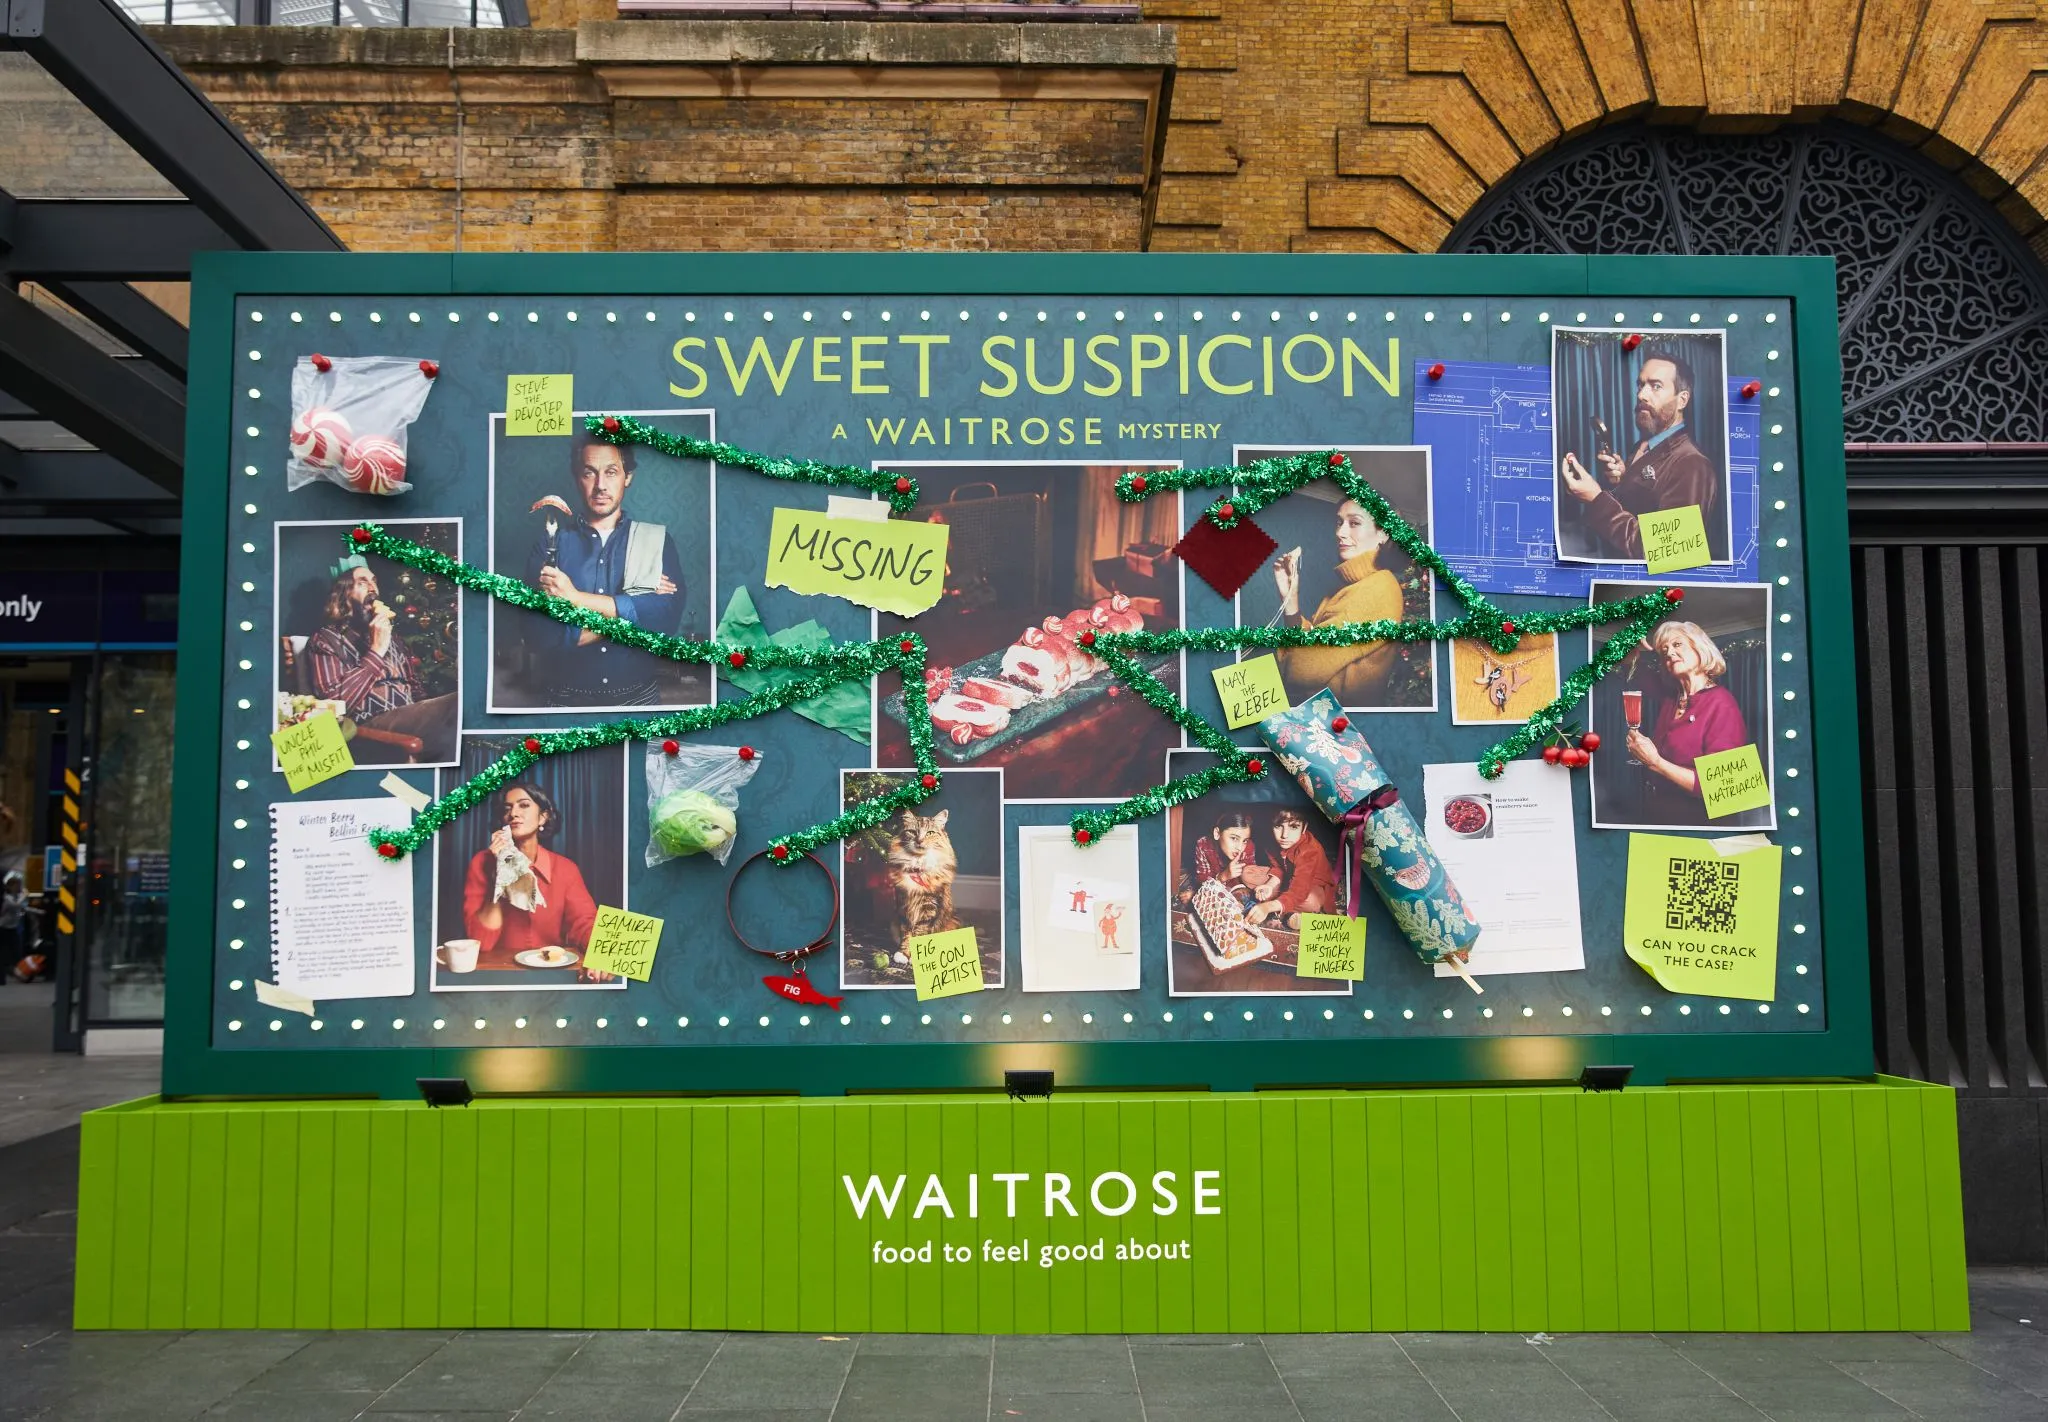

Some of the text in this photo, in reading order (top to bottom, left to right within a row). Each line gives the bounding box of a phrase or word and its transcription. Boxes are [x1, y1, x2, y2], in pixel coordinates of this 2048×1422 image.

[670, 334, 1400, 398] SWEET SUSPICION
[514, 376, 549, 395] STEVE
[524, 394, 542, 405] THE
[515, 400, 563, 421] DEVOTED
[536, 415, 565, 433] COOK
[831, 417, 1222, 445] A WAITROSE MYSTERY
[1651, 518, 1681, 536] DAVID
[1647, 533, 1704, 562] DETECTIVE
[1659, 533, 1673, 544] THE
[779, 523, 934, 586] MISSING
[1222, 669, 1247, 693] MAY
[1241, 683, 1256, 697] THE
[1233, 687, 1281, 721] REBEL
[279, 722, 315, 755] UNCLE
[299, 739, 325, 760] PHIL
[287, 746, 346, 780] THE MISFIT
[1706, 758, 1748, 782] GAMMA
[1708, 771, 1764, 806] MATRIARCH
[1721, 777, 1735, 786] THE
[331, 812, 355, 824] Berry
[329, 823, 358, 838] Bellini
[598, 913, 655, 934] SAMIRA
[1310, 917, 1346, 931] SONNY
[605, 930, 622, 939] THE
[593, 939, 651, 957] PERFECT
[916, 939, 936, 960] FIG
[919, 943, 965, 973] THE CON
[1305, 943, 1352, 959] THE STICKY
[1642, 938, 1758, 958] CAN YOU CRACK
[612, 958, 649, 976] HOST
[1313, 959, 1355, 975] FINGERS
[1664, 955, 1734, 971] THE CASE?
[930, 959, 977, 994] ARTIST
[783, 983, 801, 996] FIG
[841, 1170, 1222, 1220] WAITROSE
[872, 1237, 1191, 1268] food to feel good about
